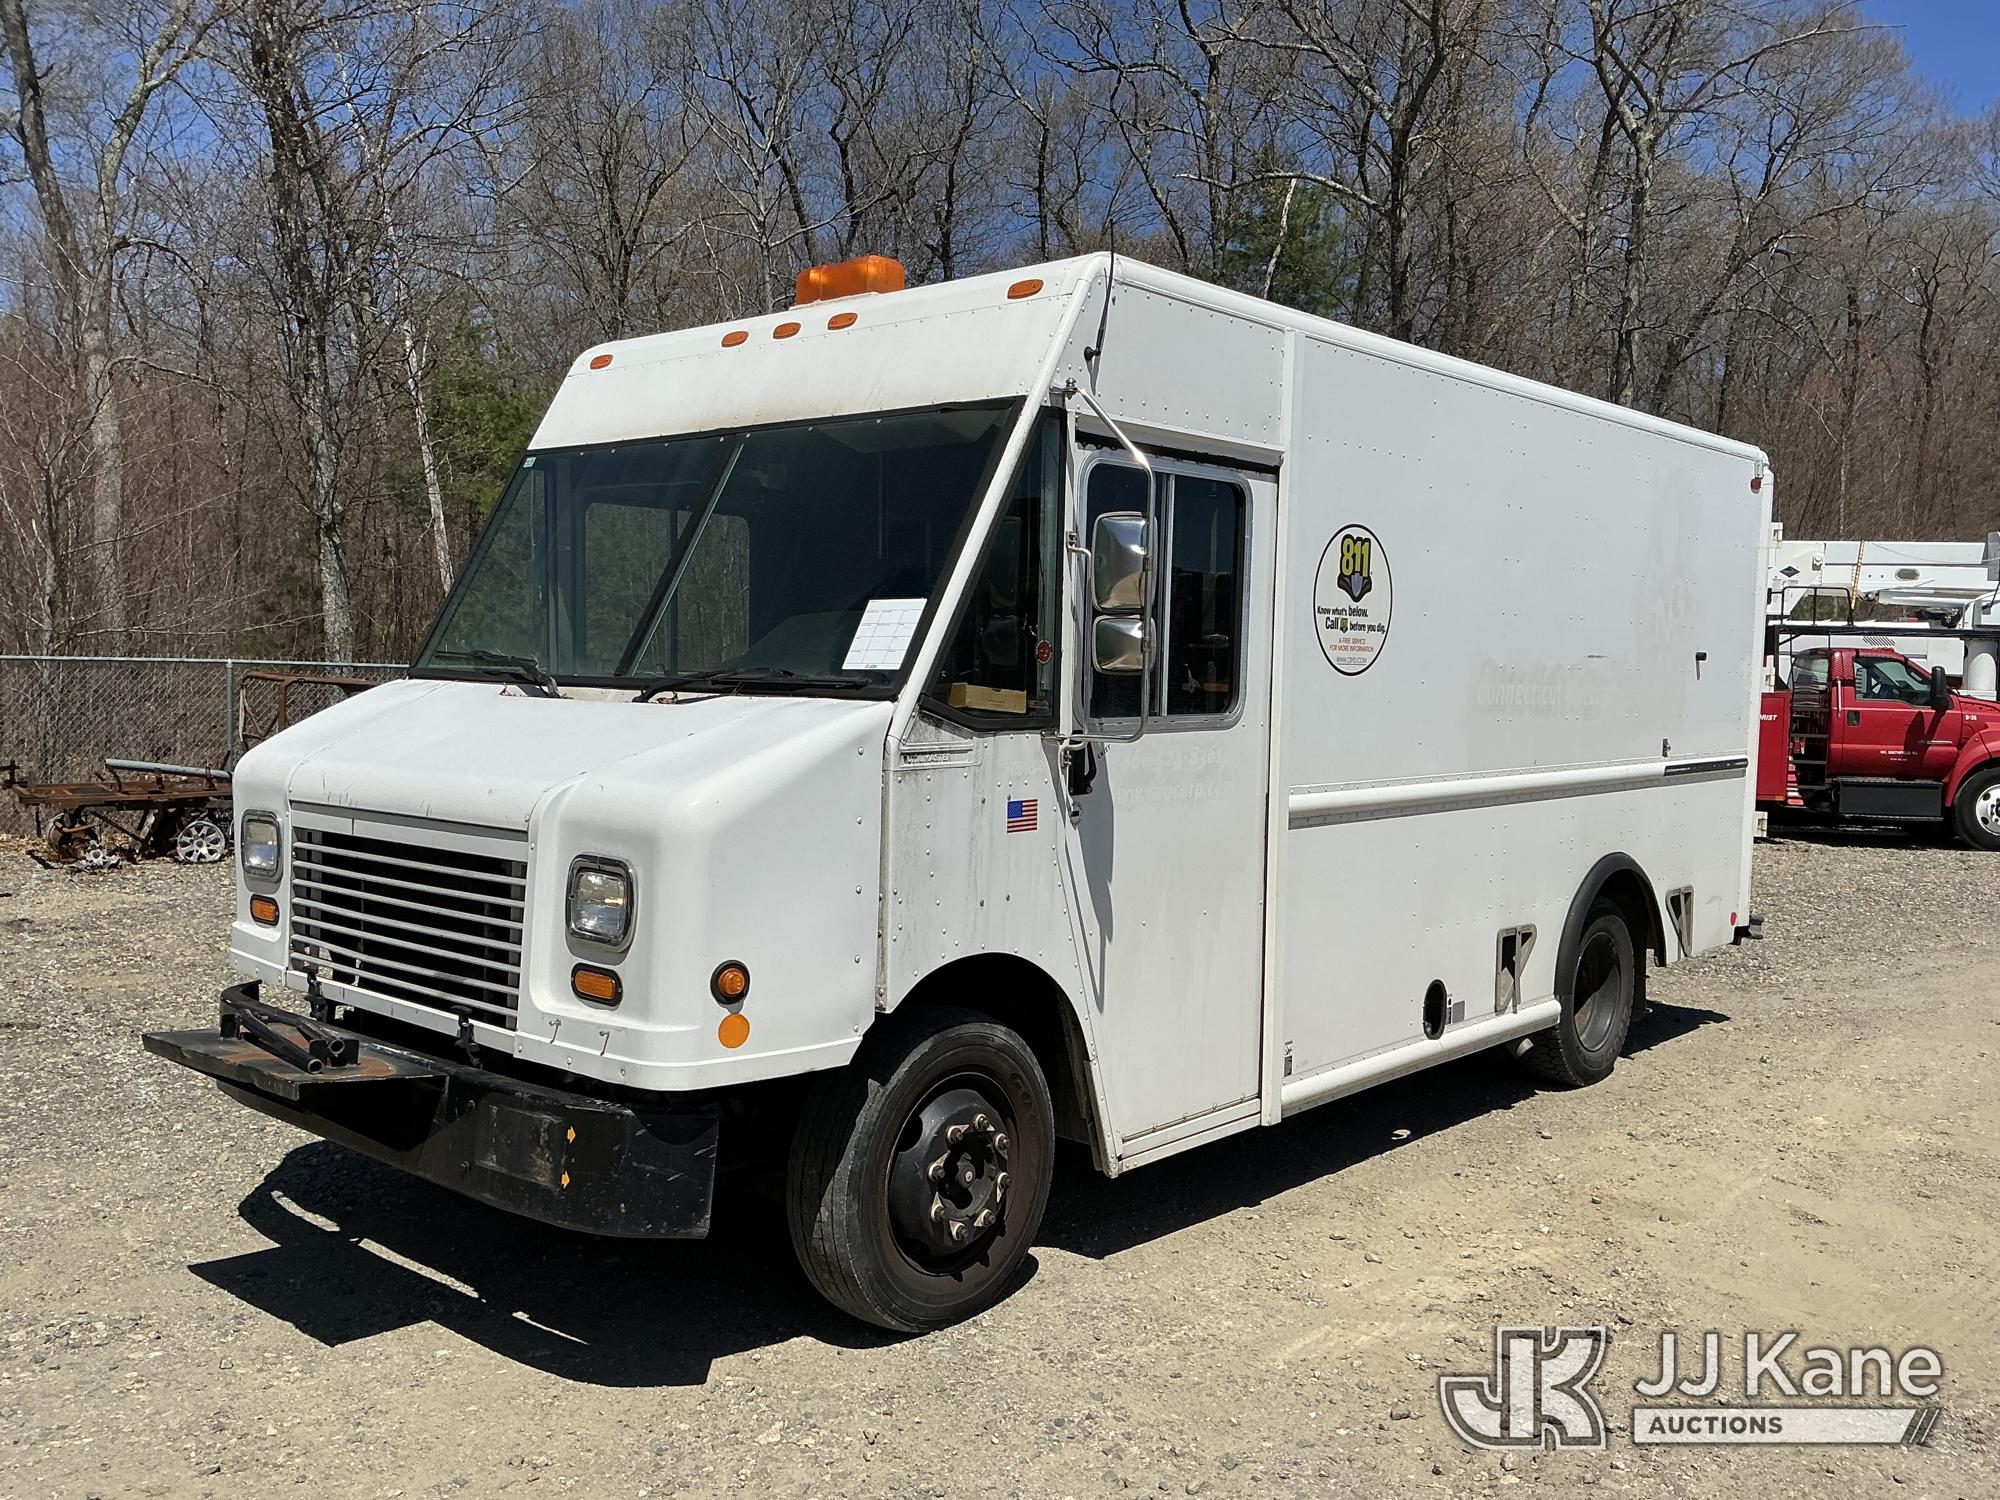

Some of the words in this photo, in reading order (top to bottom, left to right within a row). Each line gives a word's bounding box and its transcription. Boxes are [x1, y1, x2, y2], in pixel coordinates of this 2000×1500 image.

[1341, 535, 1371, 577] 811
[1317, 606, 1331, 615] Know
[1332, 607, 1347, 616] what's
[1348, 604, 1368, 617] below.
[1325, 616, 1339, 630] Call
[1349, 621, 1366, 631] before
[1367, 623, 1376, 633] you
[1376, 623, 1386, 635] dig.
[1350, 645, 1374, 653] INFORMATION
